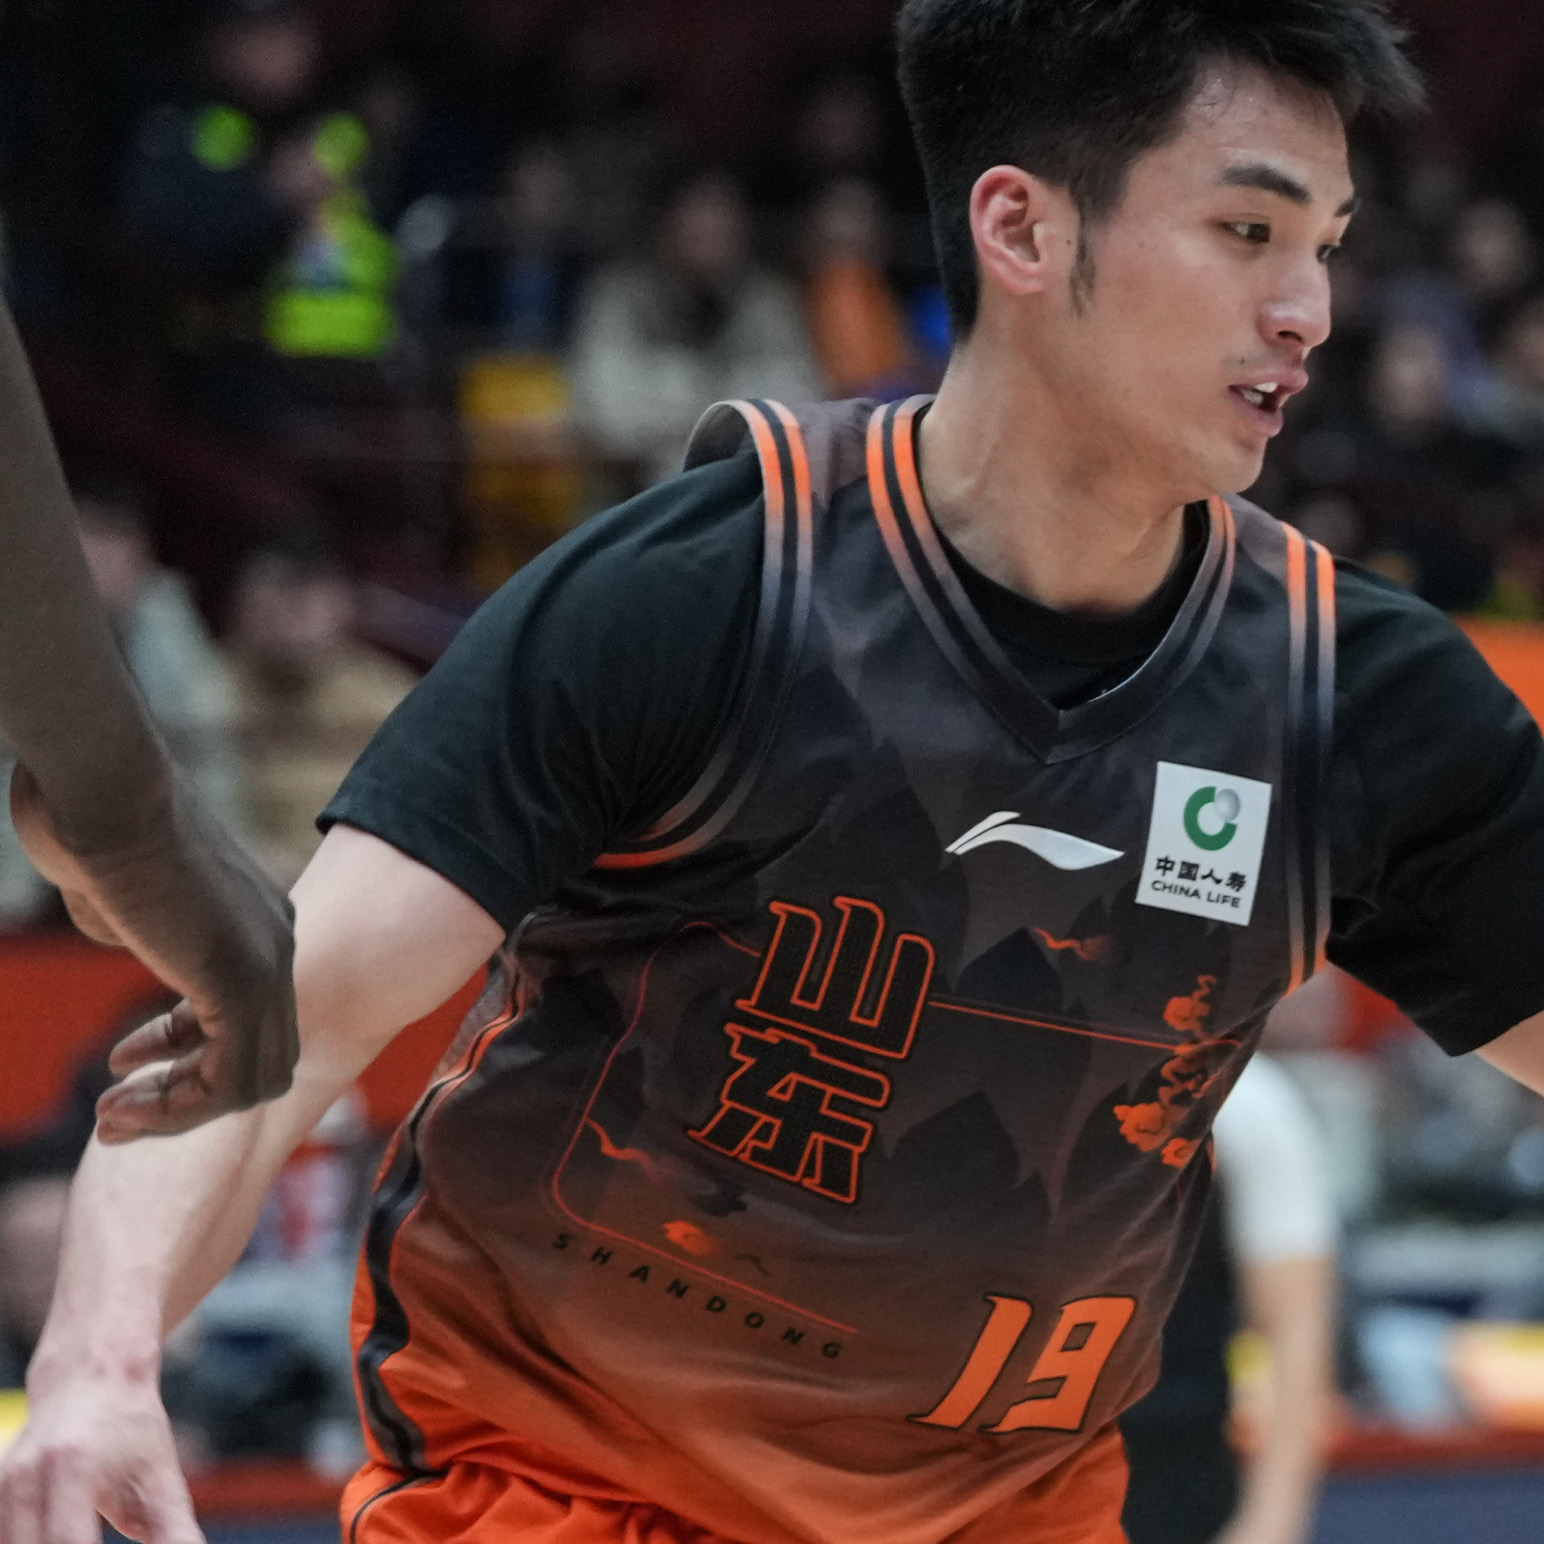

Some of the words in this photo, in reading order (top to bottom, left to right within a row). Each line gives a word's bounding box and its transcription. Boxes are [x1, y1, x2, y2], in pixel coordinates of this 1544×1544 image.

[1151, 880, 1201, 900] CHINA
[1206, 891, 1242, 909] LIFE
[1155, 856, 1247, 892] 中国人寿
[686, 896, 937, 1203] 山东
[552, 1233, 843, 1359] SHANDONG
[908, 1294, 1137, 1434] 19
